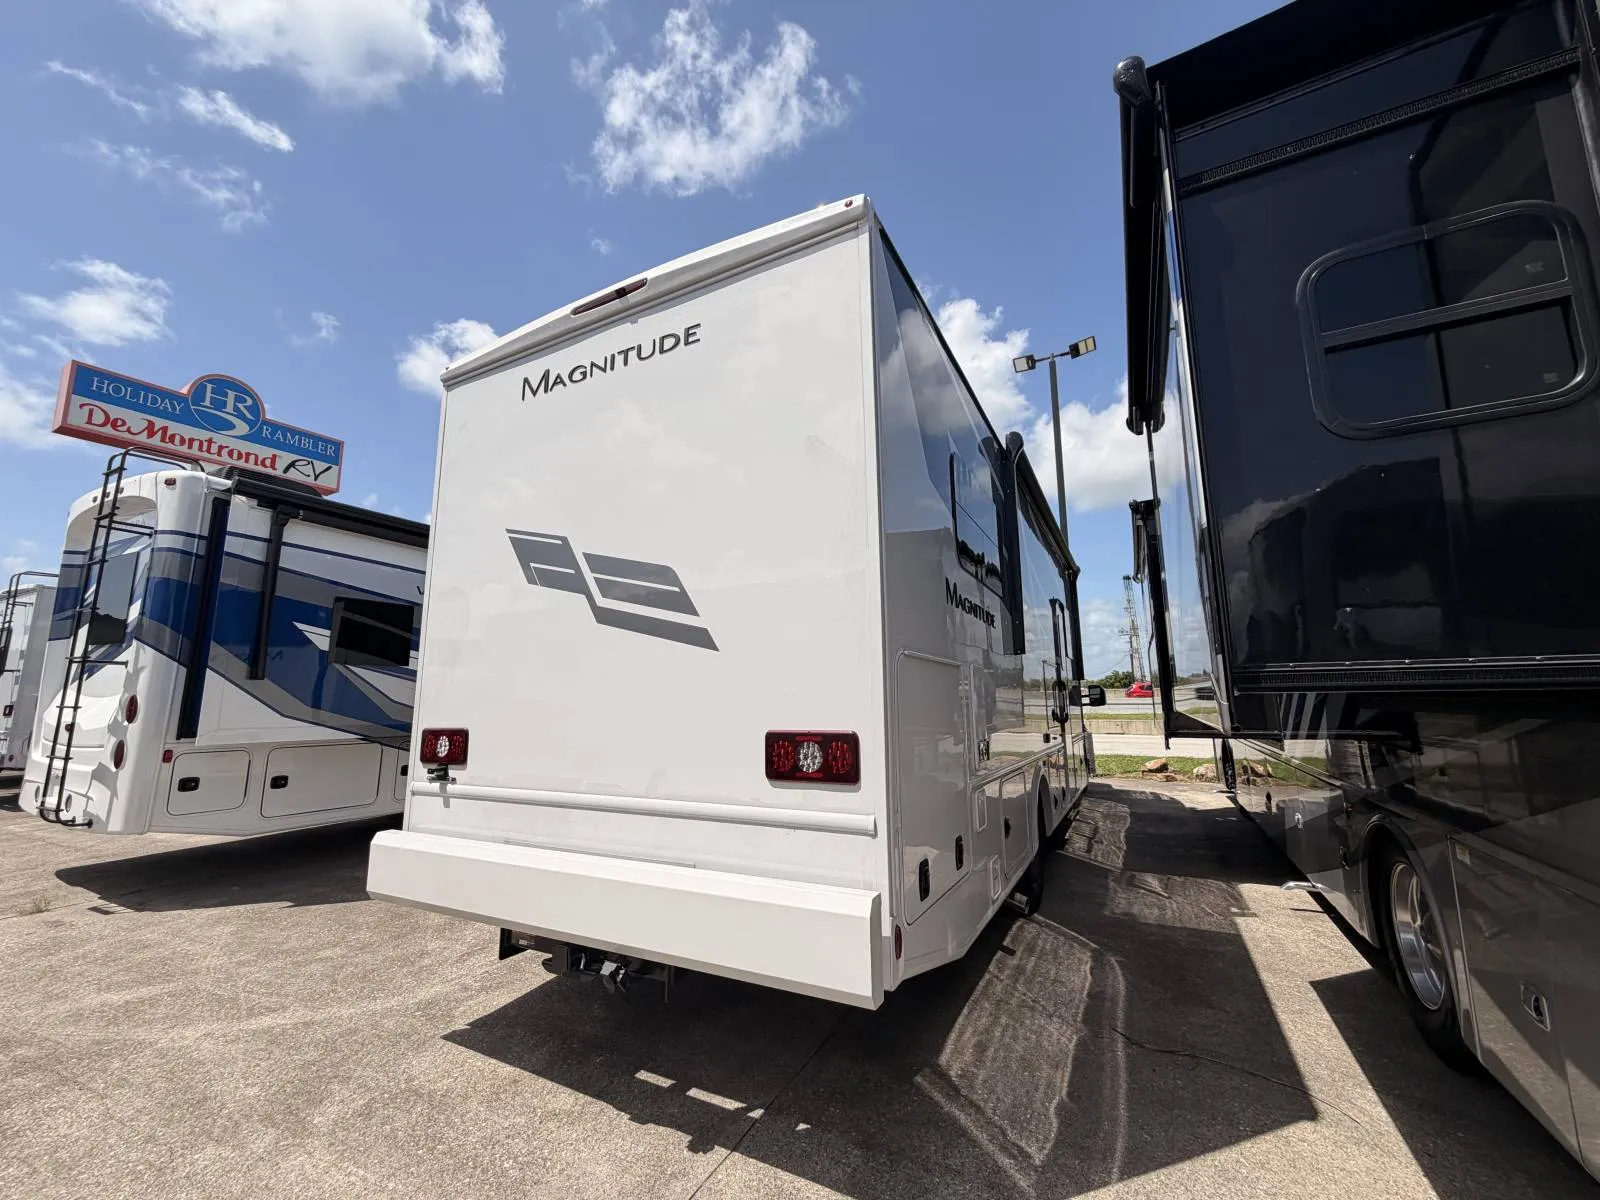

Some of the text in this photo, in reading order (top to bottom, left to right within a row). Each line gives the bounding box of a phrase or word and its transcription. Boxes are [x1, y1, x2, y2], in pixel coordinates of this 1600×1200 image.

[521, 323, 701, 402] MAGNITUDE
[79, 402, 333, 482] DeMontrond RV
[90, 376, 336, 457] HOLIDAY RAMBLER
[945, 576, 996, 629] MAGNITUDE
